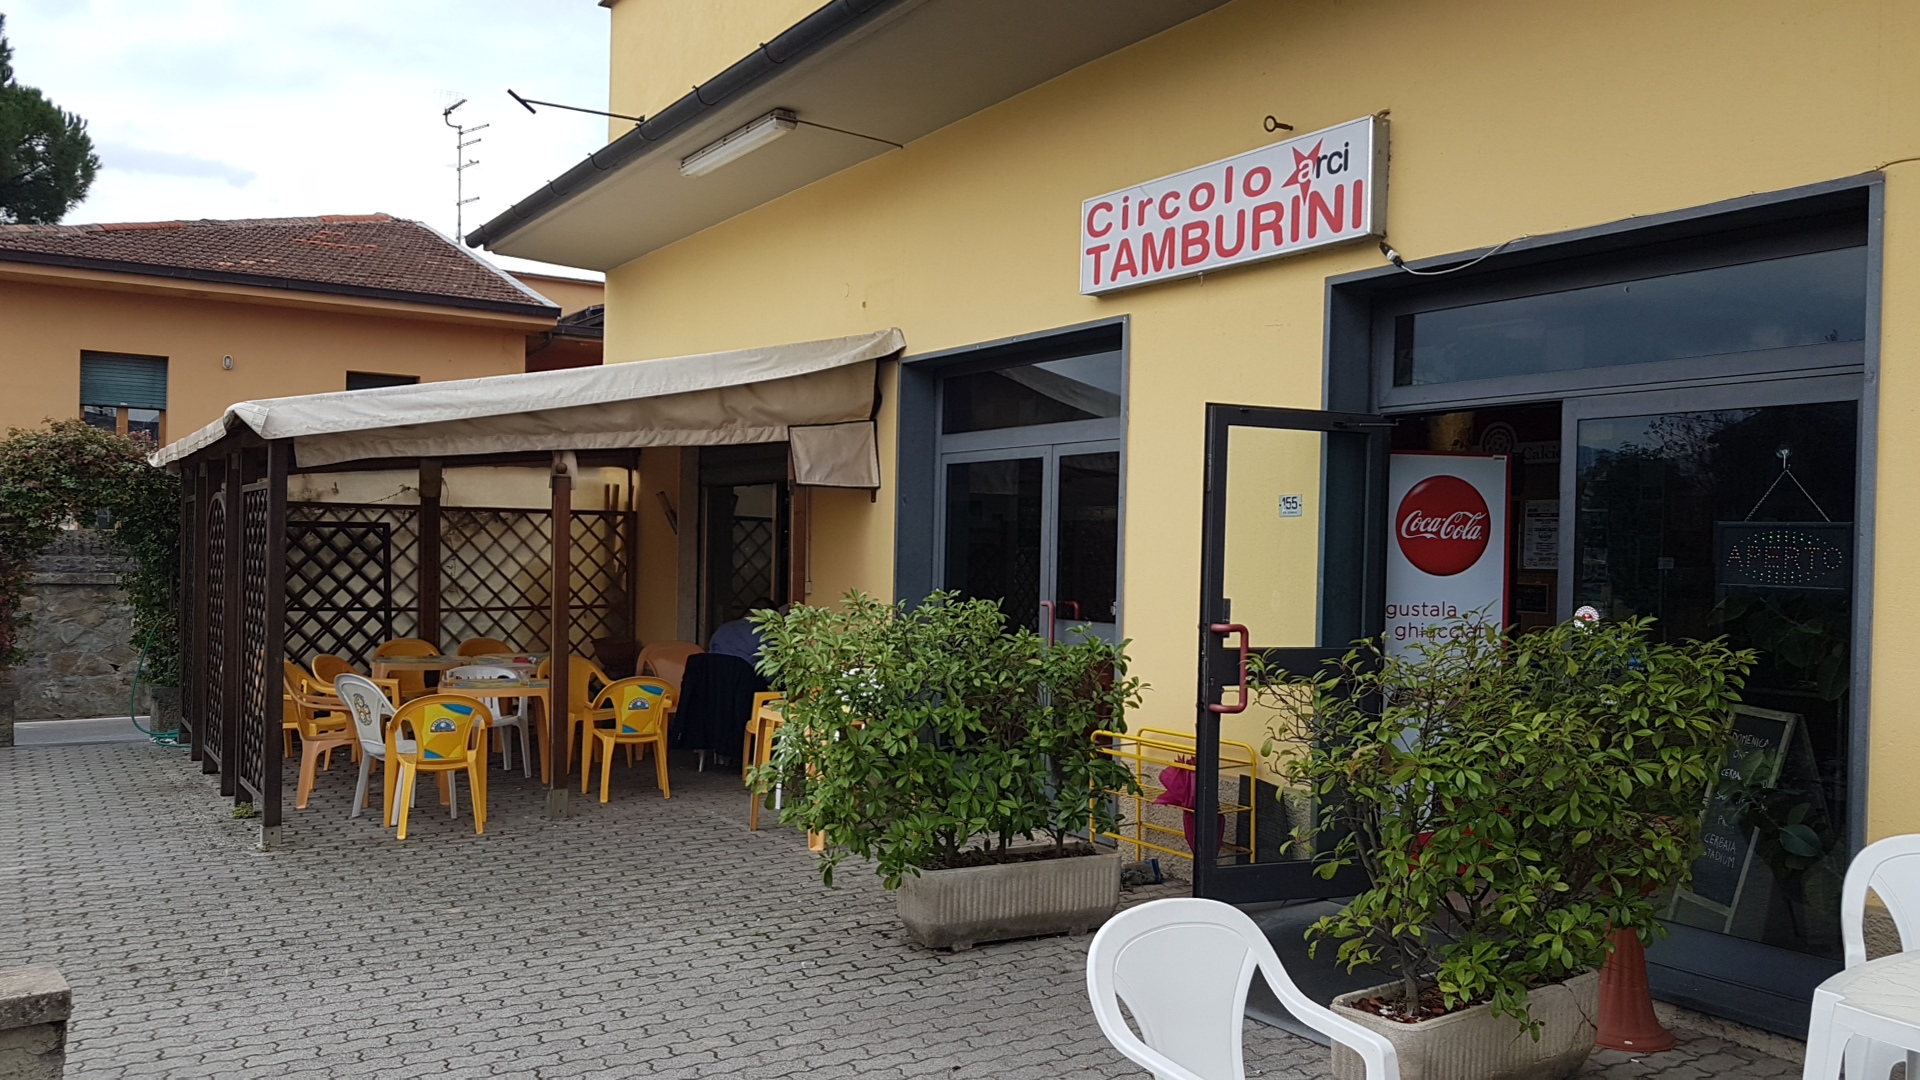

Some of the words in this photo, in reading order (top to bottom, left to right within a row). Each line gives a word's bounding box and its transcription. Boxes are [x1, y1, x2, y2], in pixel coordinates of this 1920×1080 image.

[1087, 166, 1272, 238] Circolo
[1297, 141, 1349, 183] arci
[1086, 179, 1363, 285] TAMBURINI
[1281, 496, 1298, 510] 155
[1401, 510, 1487, 540] Coca-Cola
[1726, 545, 1842, 569] APERTO
[1386, 601, 1457, 619] gustala
